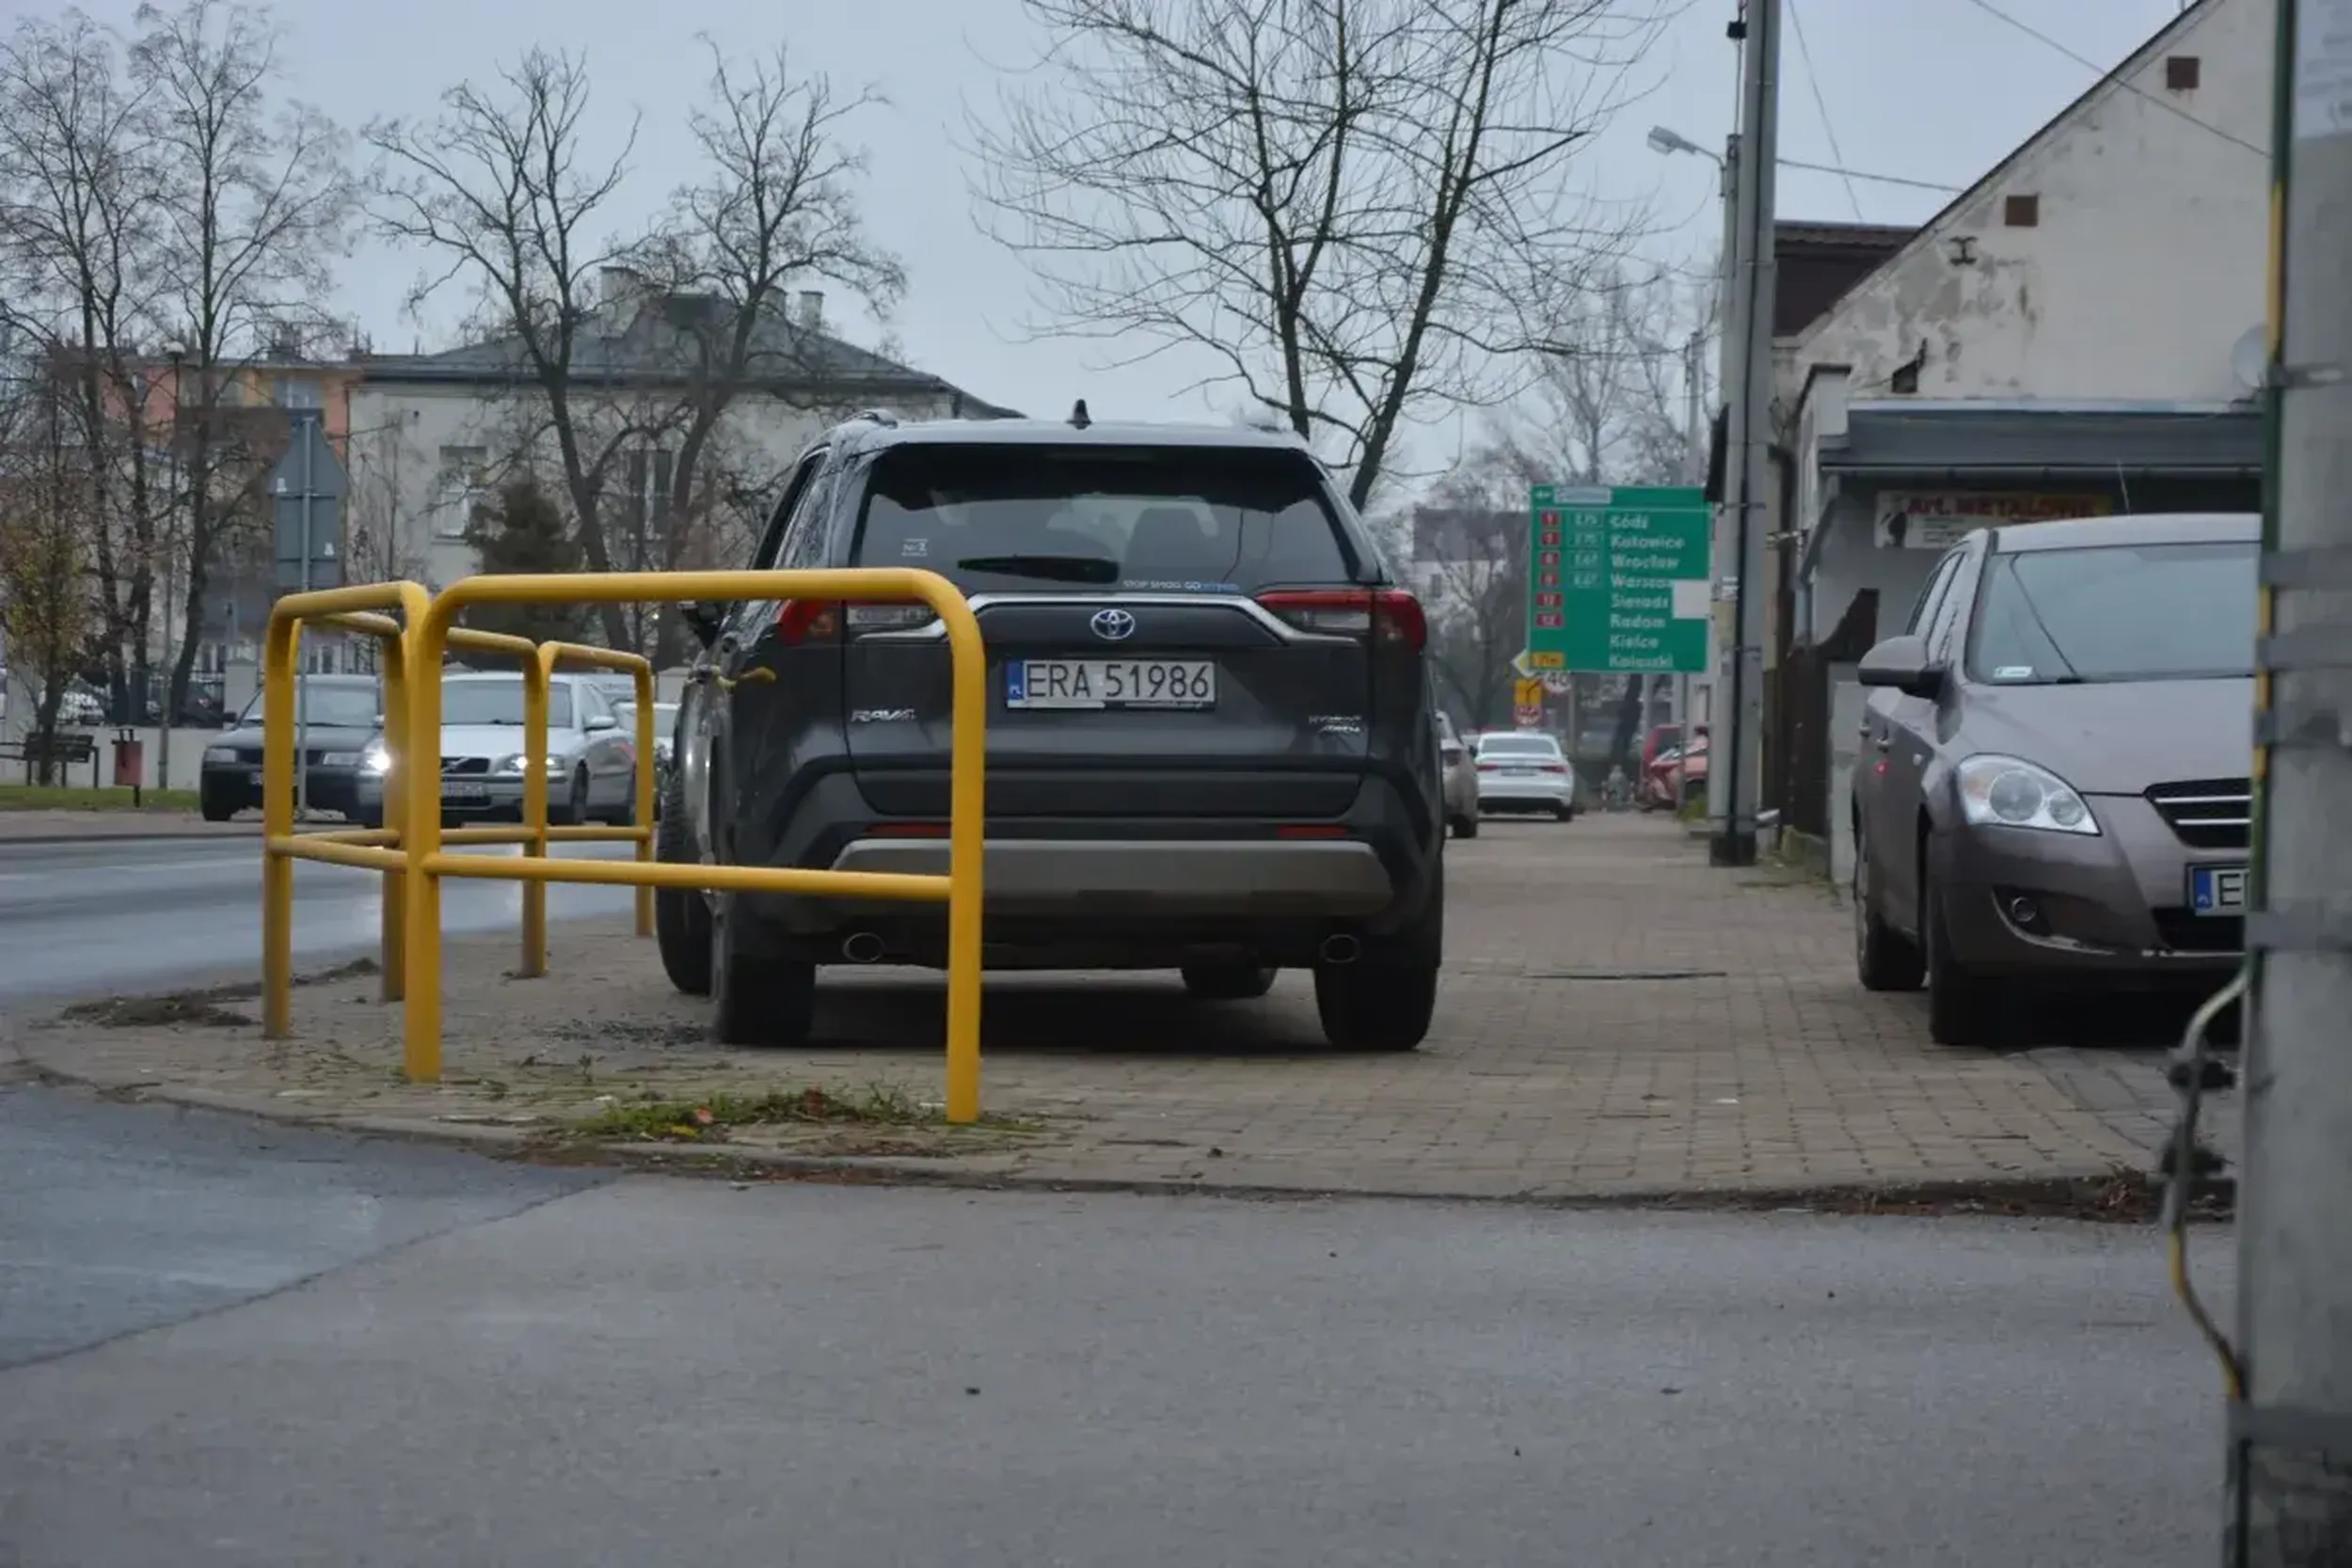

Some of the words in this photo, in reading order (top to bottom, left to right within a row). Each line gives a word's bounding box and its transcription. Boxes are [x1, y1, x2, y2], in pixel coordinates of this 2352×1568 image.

[1610, 533, 1685, 549] Katowice
[1610, 553, 1680, 569] Wrocław
[1610, 592, 1669, 609] Sieradz
[1609, 613, 1666, 628] Radom
[1609, 633, 1661, 649] Kielce
[1026, 664, 1091, 698] ERA
[1105, 664, 1209, 698] 51986
